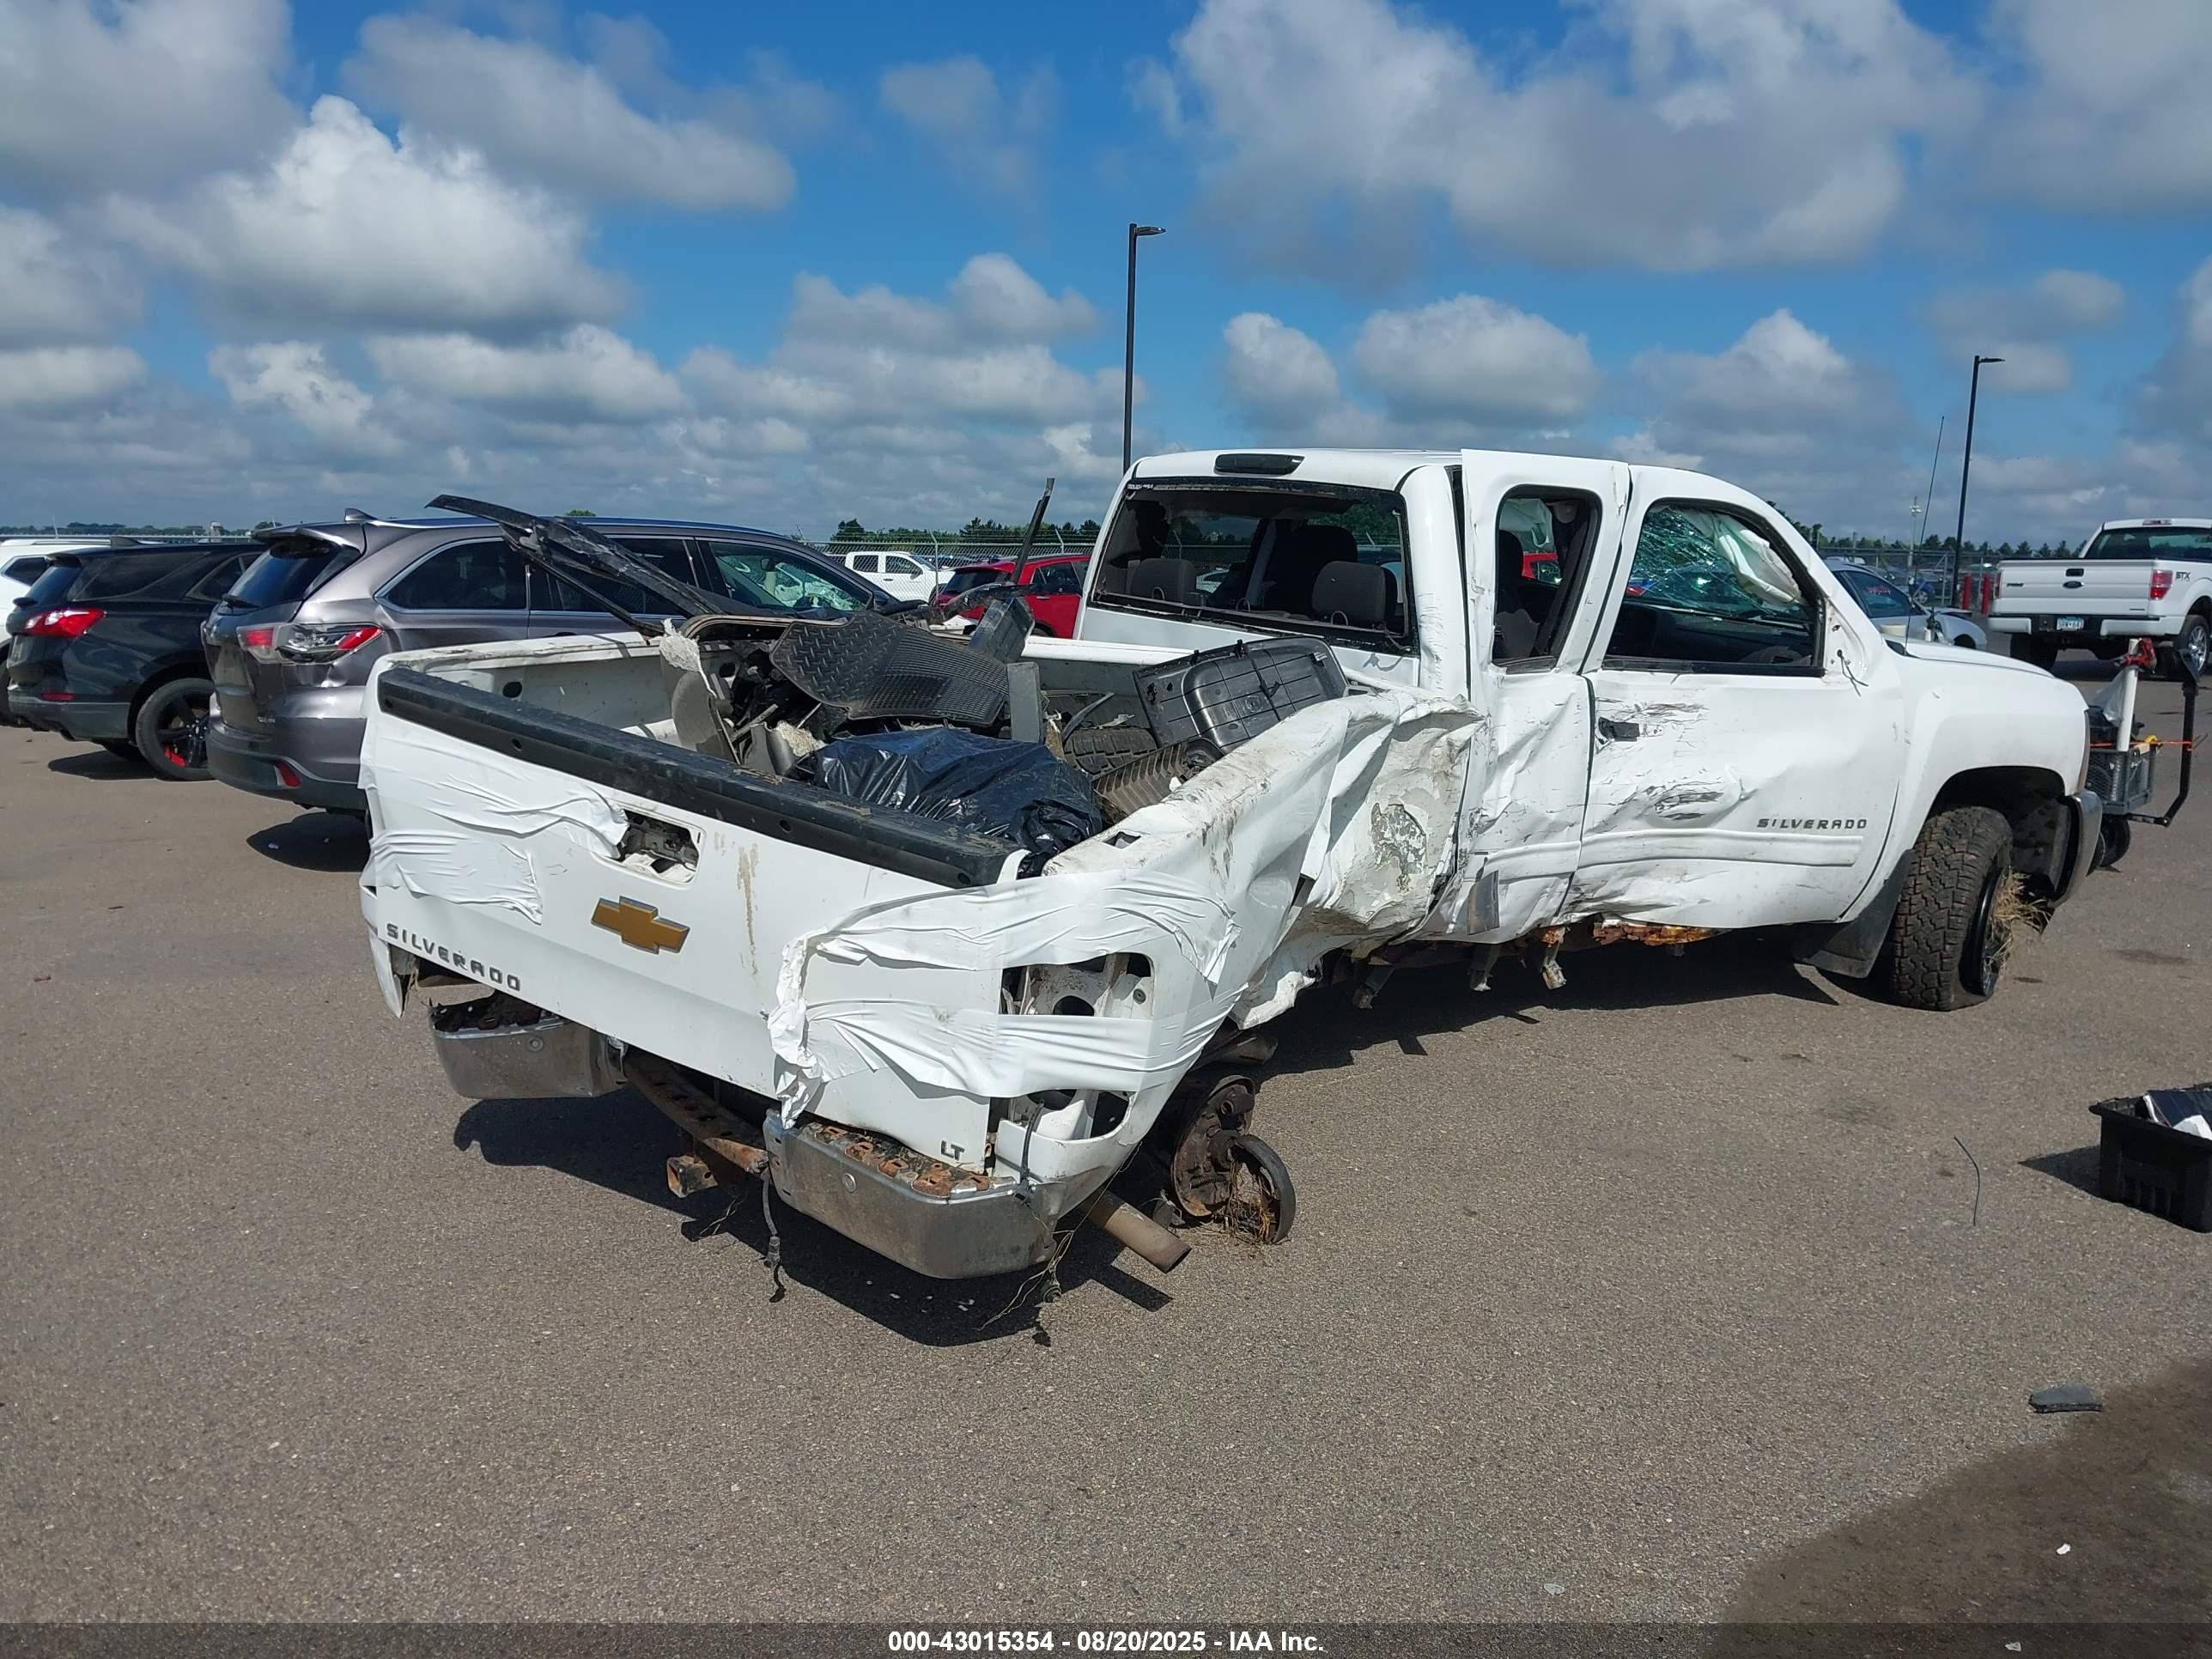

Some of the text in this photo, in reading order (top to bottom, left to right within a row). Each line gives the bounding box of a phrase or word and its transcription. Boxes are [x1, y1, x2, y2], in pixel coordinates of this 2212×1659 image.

[1756, 817, 1869, 830] SILVERADO
[386, 922, 522, 992] SILVERADO
[940, 1139, 966, 1162] LT
